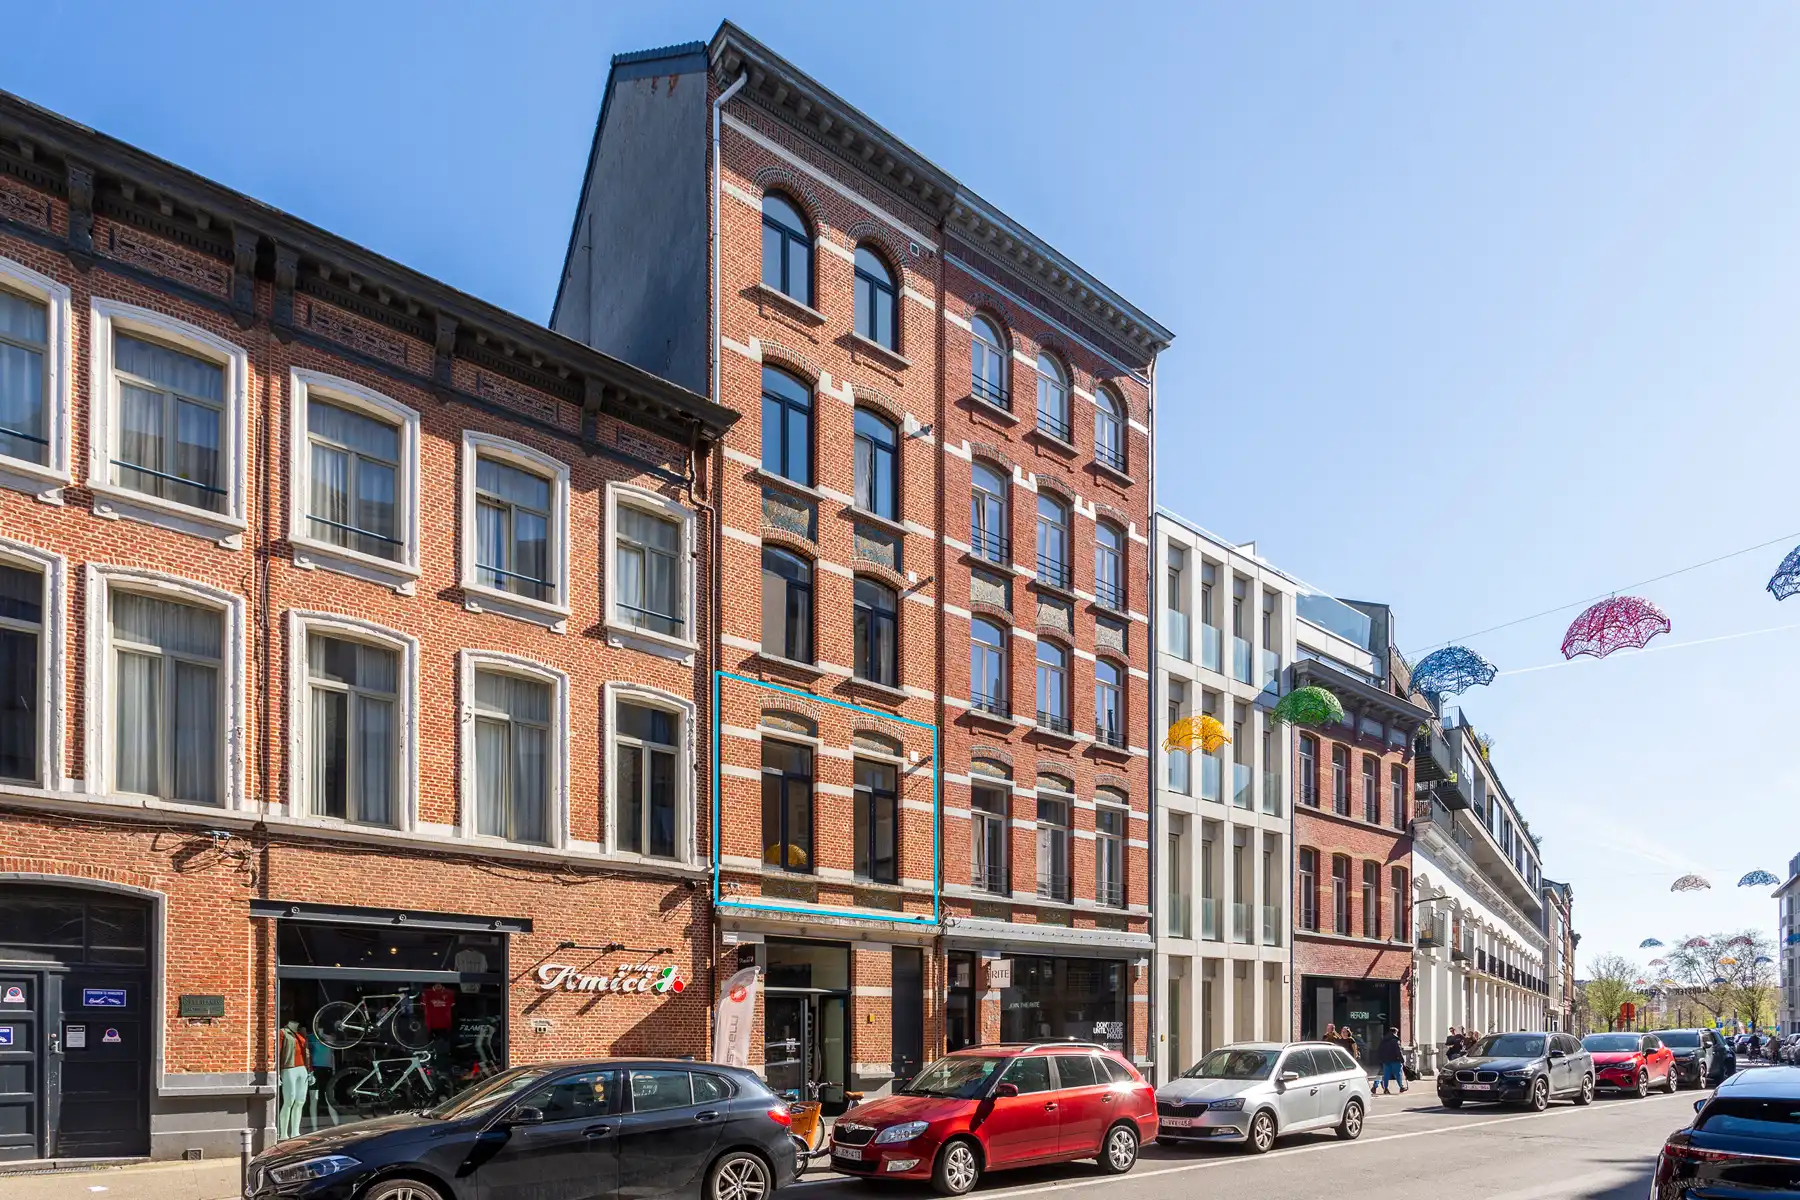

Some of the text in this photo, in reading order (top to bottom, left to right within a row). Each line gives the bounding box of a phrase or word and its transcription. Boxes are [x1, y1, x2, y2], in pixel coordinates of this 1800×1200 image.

[538, 964, 658, 992] Amici
[992, 969, 1009, 979] RITE
[1350, 1011, 1370, 1019] REFORM
